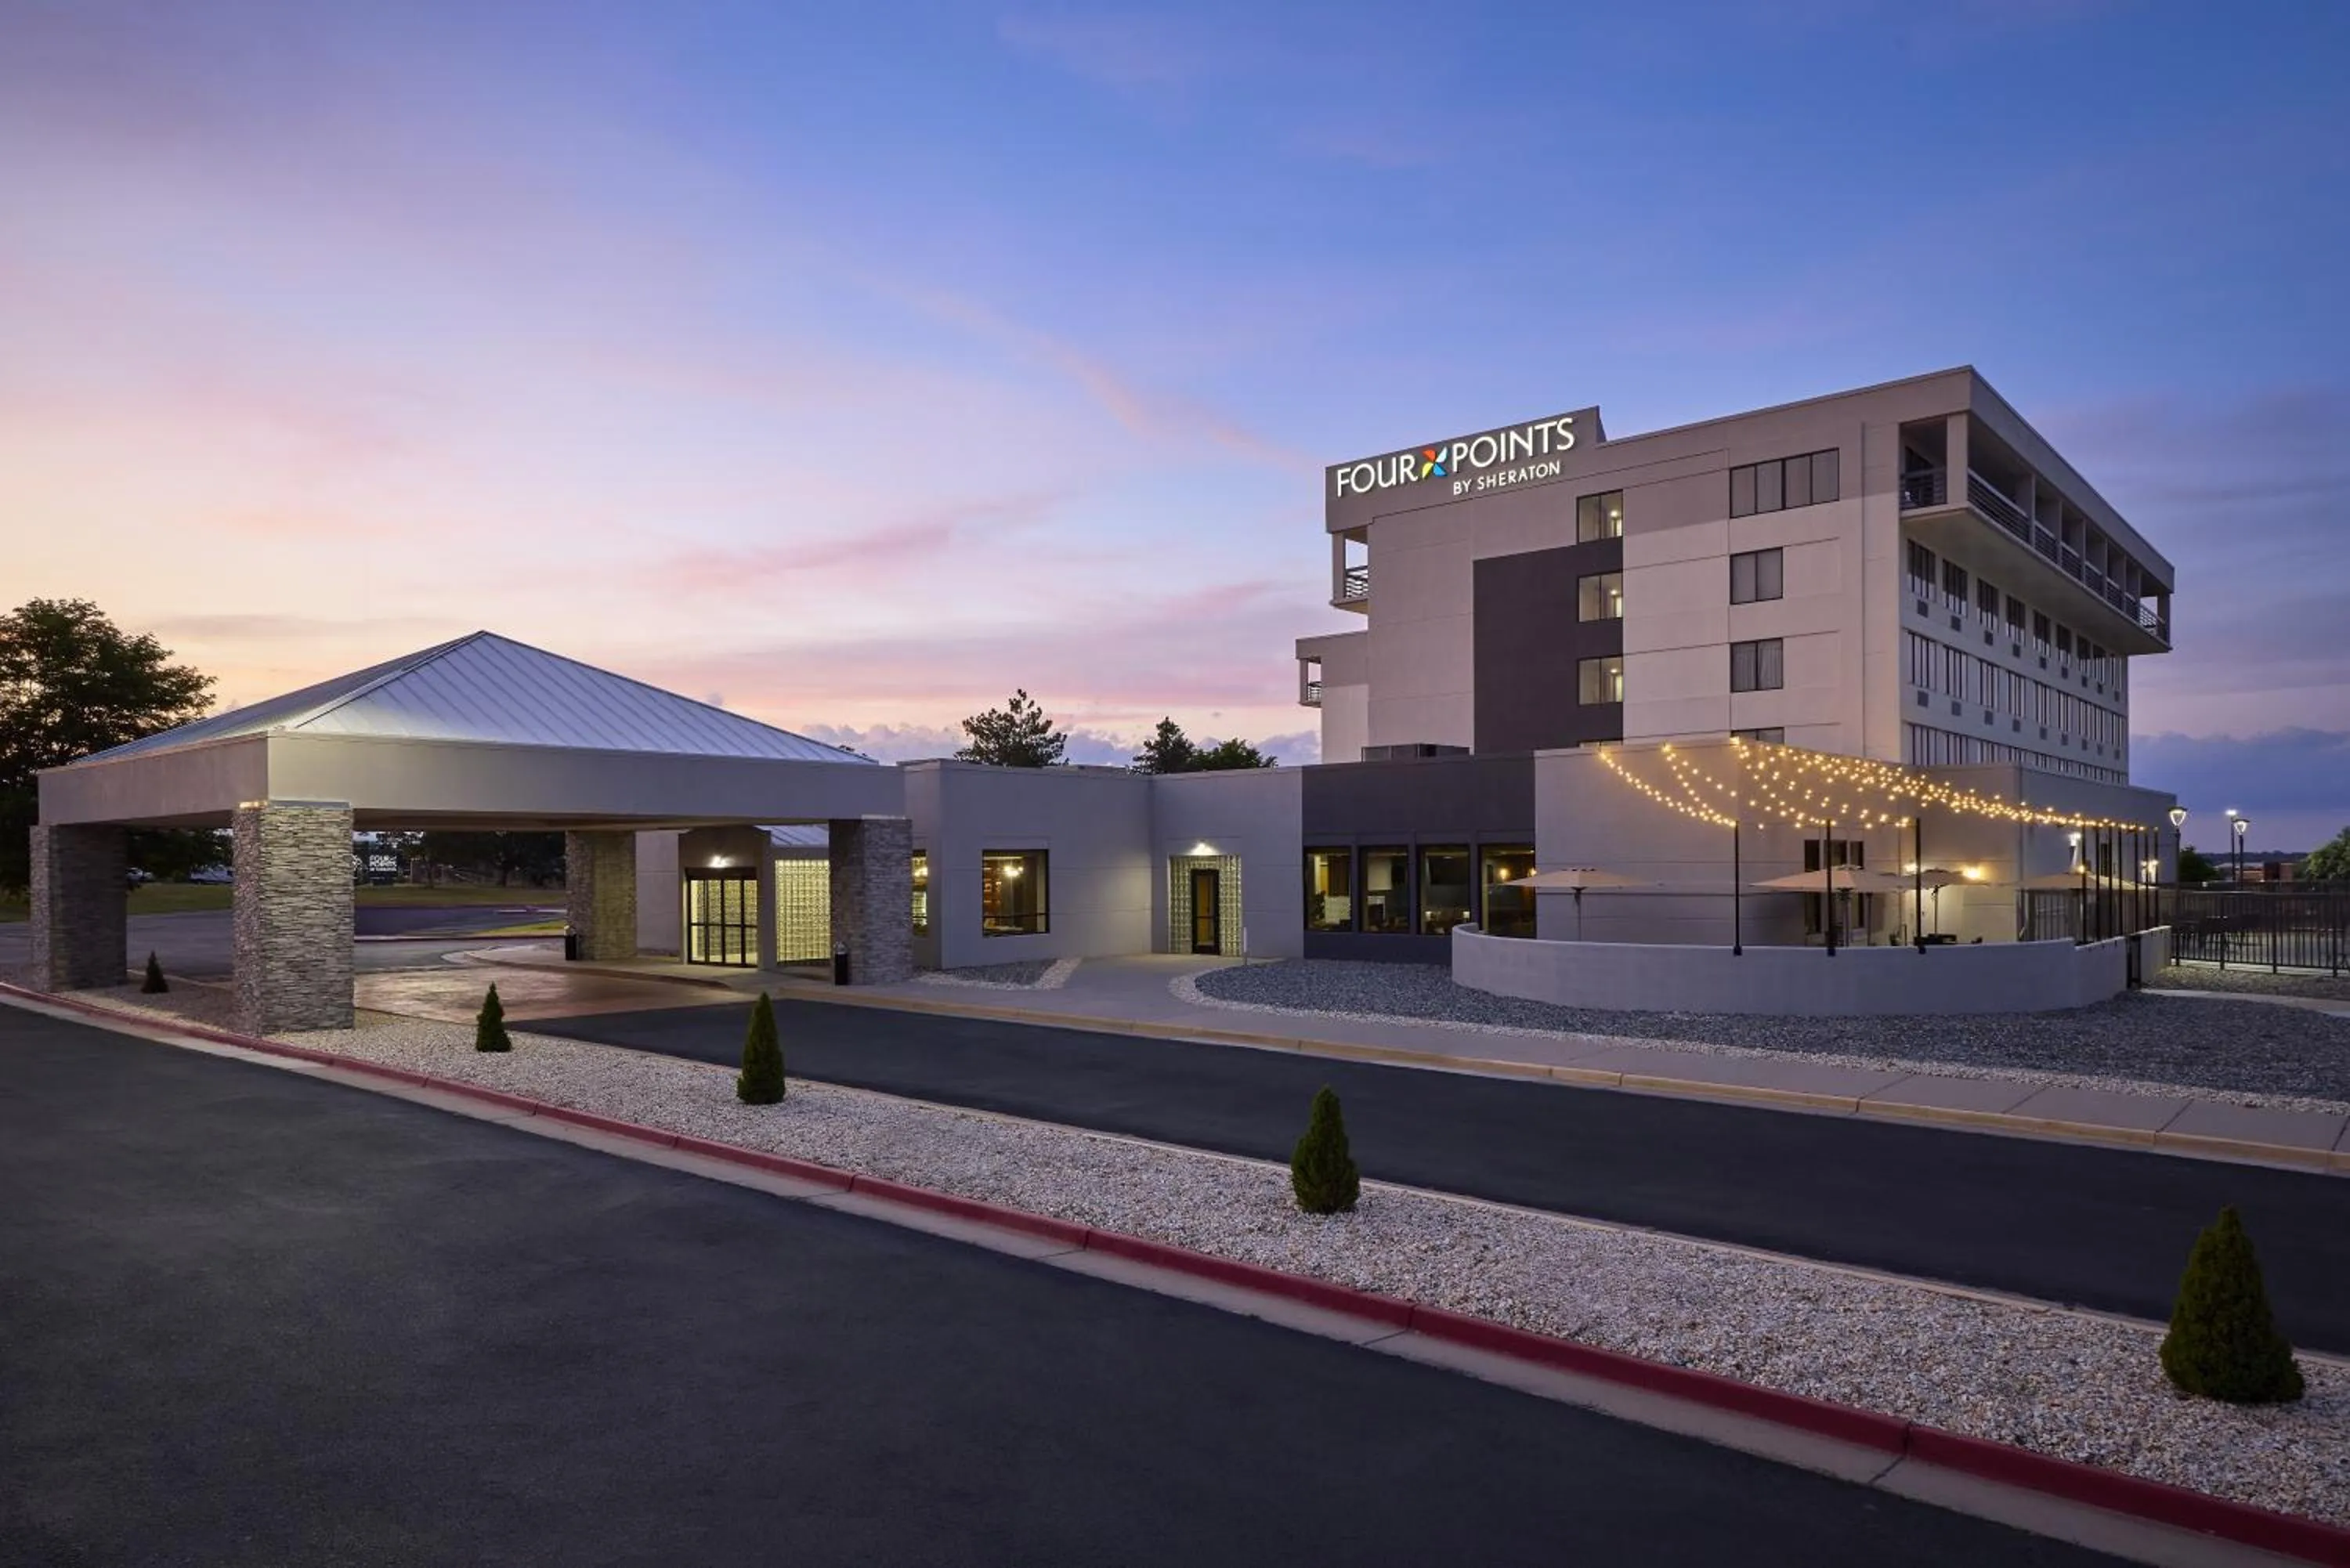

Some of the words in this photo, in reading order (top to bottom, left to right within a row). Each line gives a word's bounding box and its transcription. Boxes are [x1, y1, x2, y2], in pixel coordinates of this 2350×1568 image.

[1336, 453, 1419, 497] FOUR
[1452, 417, 1575, 472] POINTS
[1453, 479, 1473, 496] BY
[1477, 460, 1560, 491] SHERATON
